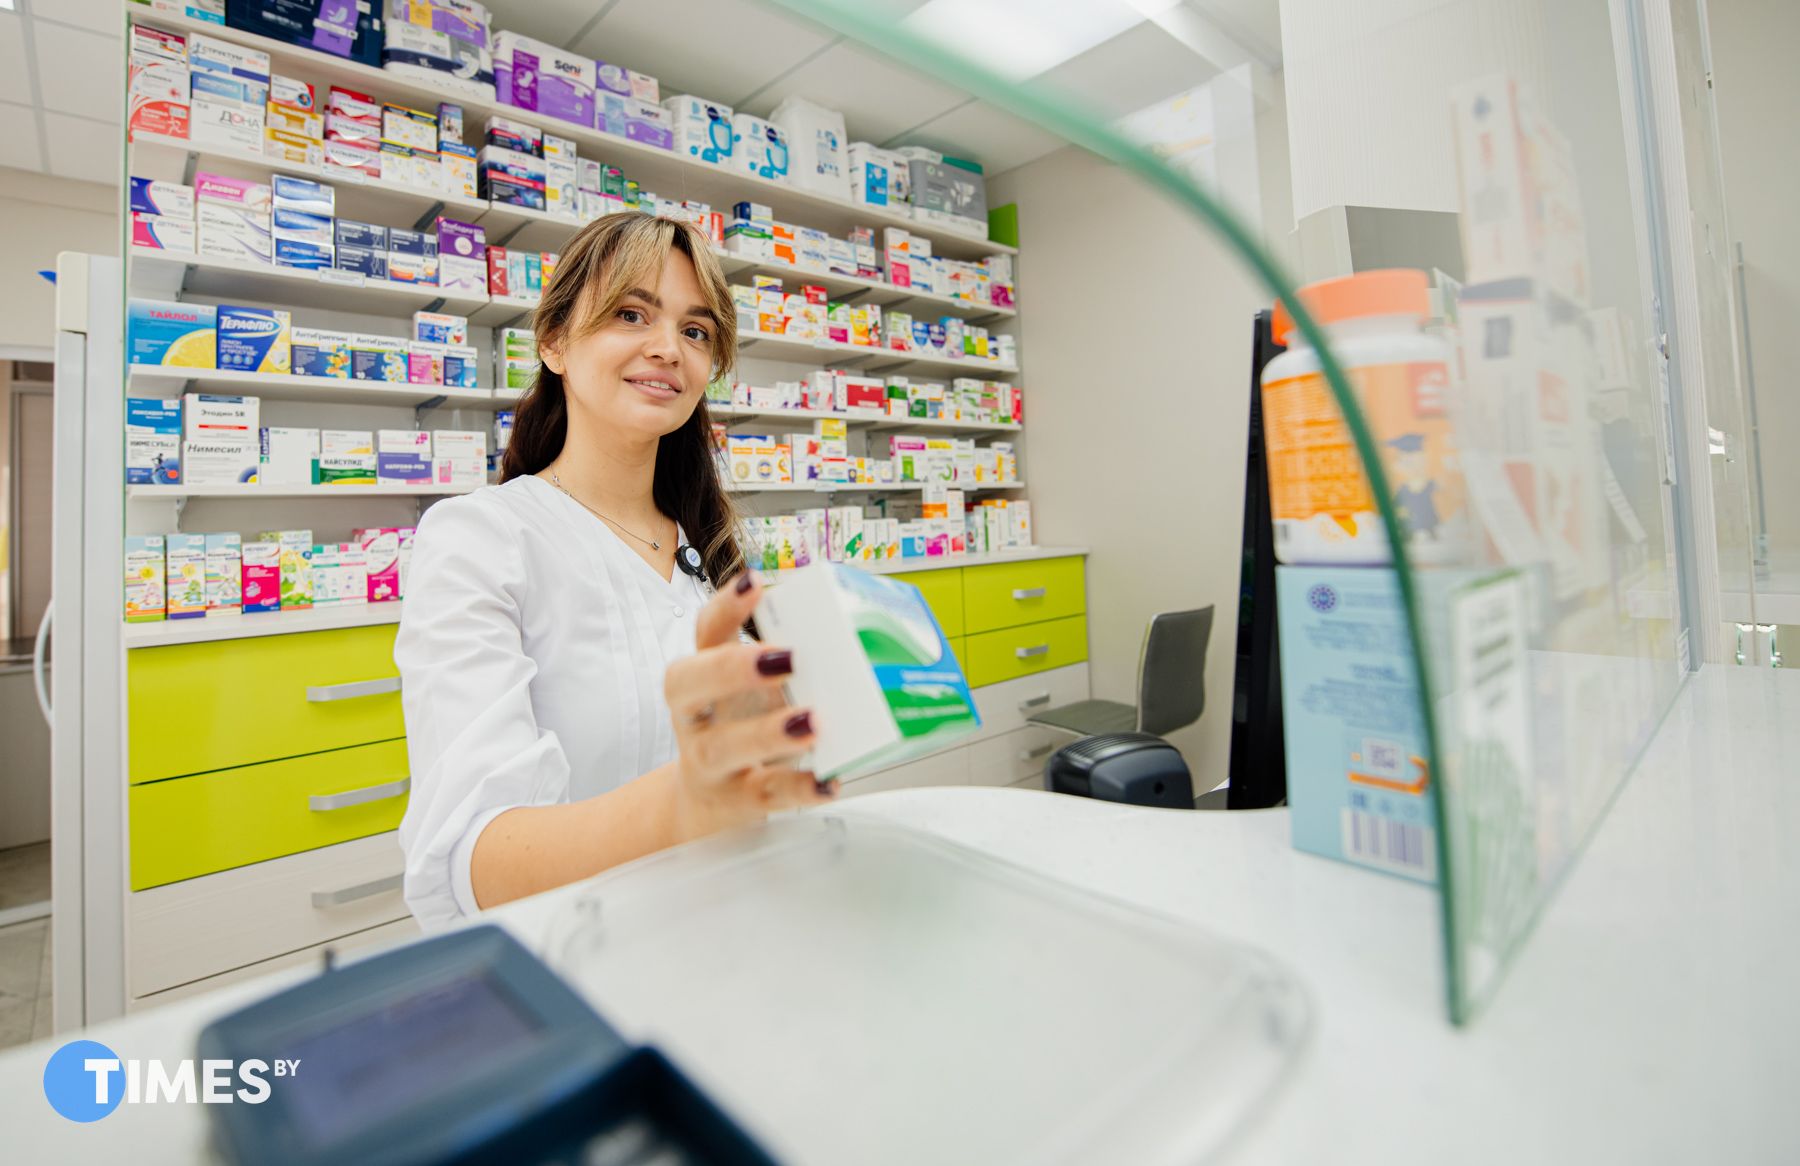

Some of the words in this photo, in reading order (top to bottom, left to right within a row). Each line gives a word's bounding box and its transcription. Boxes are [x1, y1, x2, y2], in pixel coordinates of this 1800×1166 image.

[554, 59, 582, 74] seni
[219, 110, 260, 129] ДОНА
[220, 316, 275, 332] ТЕРАФЛЮ
[187, 443, 242, 454] Нимесил
